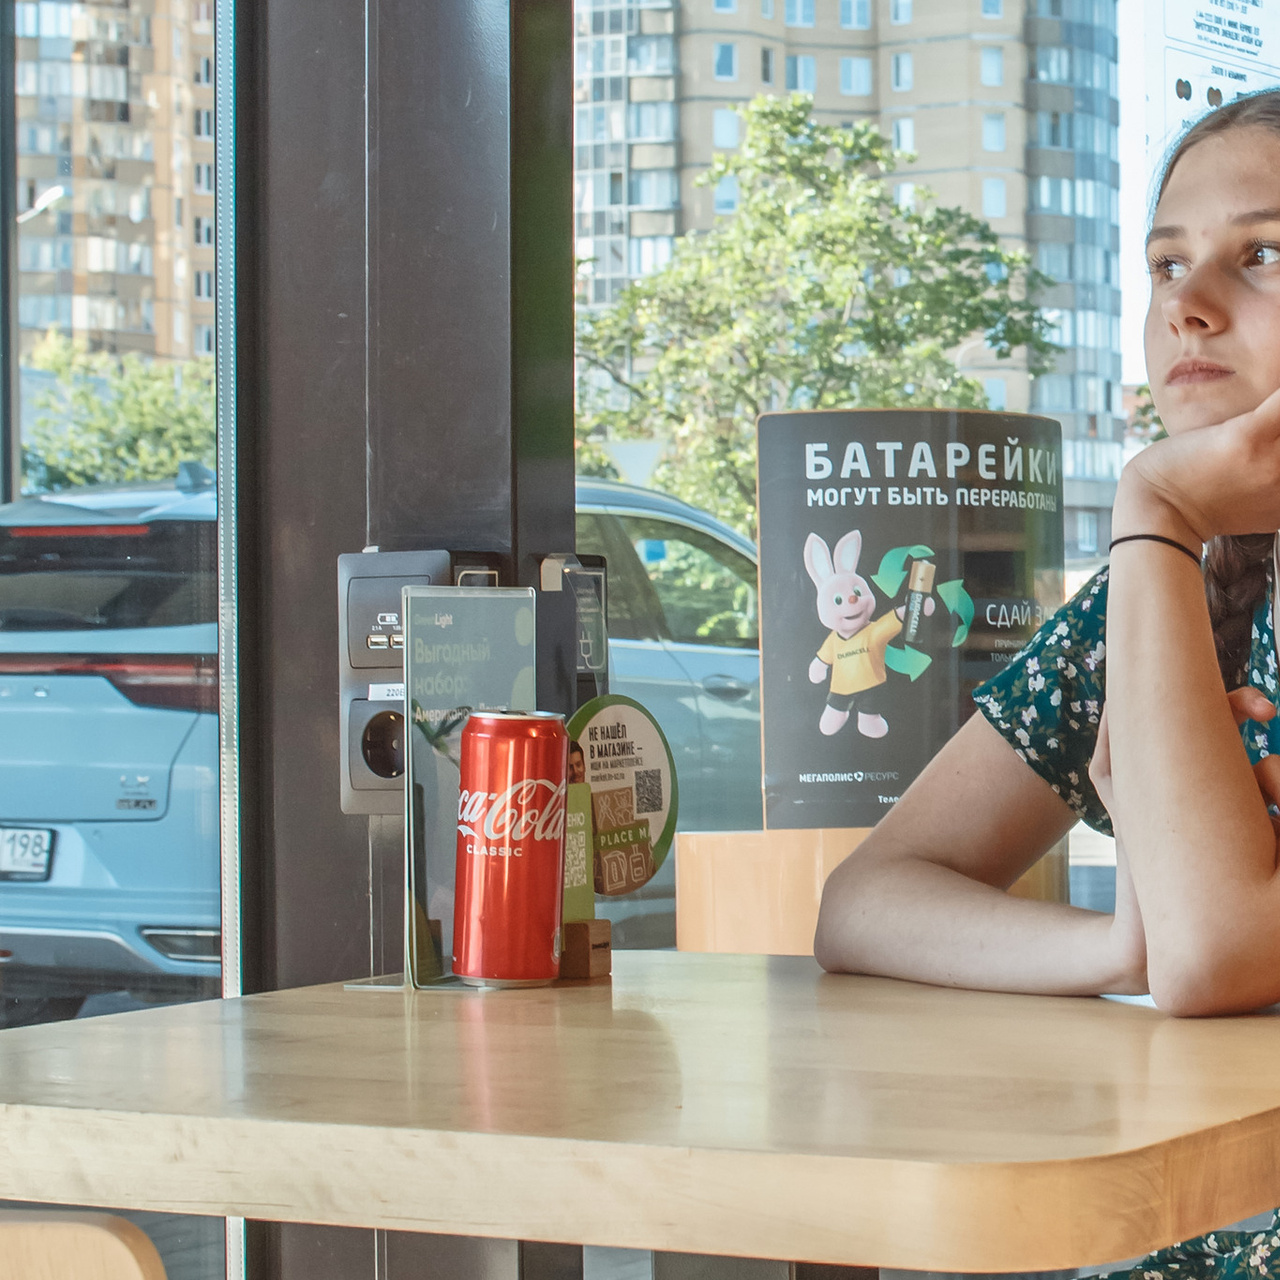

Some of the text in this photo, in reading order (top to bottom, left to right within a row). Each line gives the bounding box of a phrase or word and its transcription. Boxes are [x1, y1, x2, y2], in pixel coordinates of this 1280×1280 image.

[805, 436, 1057, 486] БАТАРЕЙКИ
[807, 487, 1057, 512] МОГУТ БЫТЬ ПЕРЕРАБОТАНЫ
[986, 600, 1031, 628] СДАЙ
[414, 637, 491, 666] Выгодный
[589, 722, 627, 741] НЕ НАШЁЛ
[589, 741, 635, 759] В МАГАЗИНЕ
[799, 771, 899, 782] МЕГАПОЛИС РЕСУРС
[457, 778, 566, 841] ca-Cola
[567, 813, 585, 827] ЕНЮ
[7, 833, 44, 858] 198
[600, 830, 633, 847] PLACE
[466, 844, 523, 857] CLASSIC
